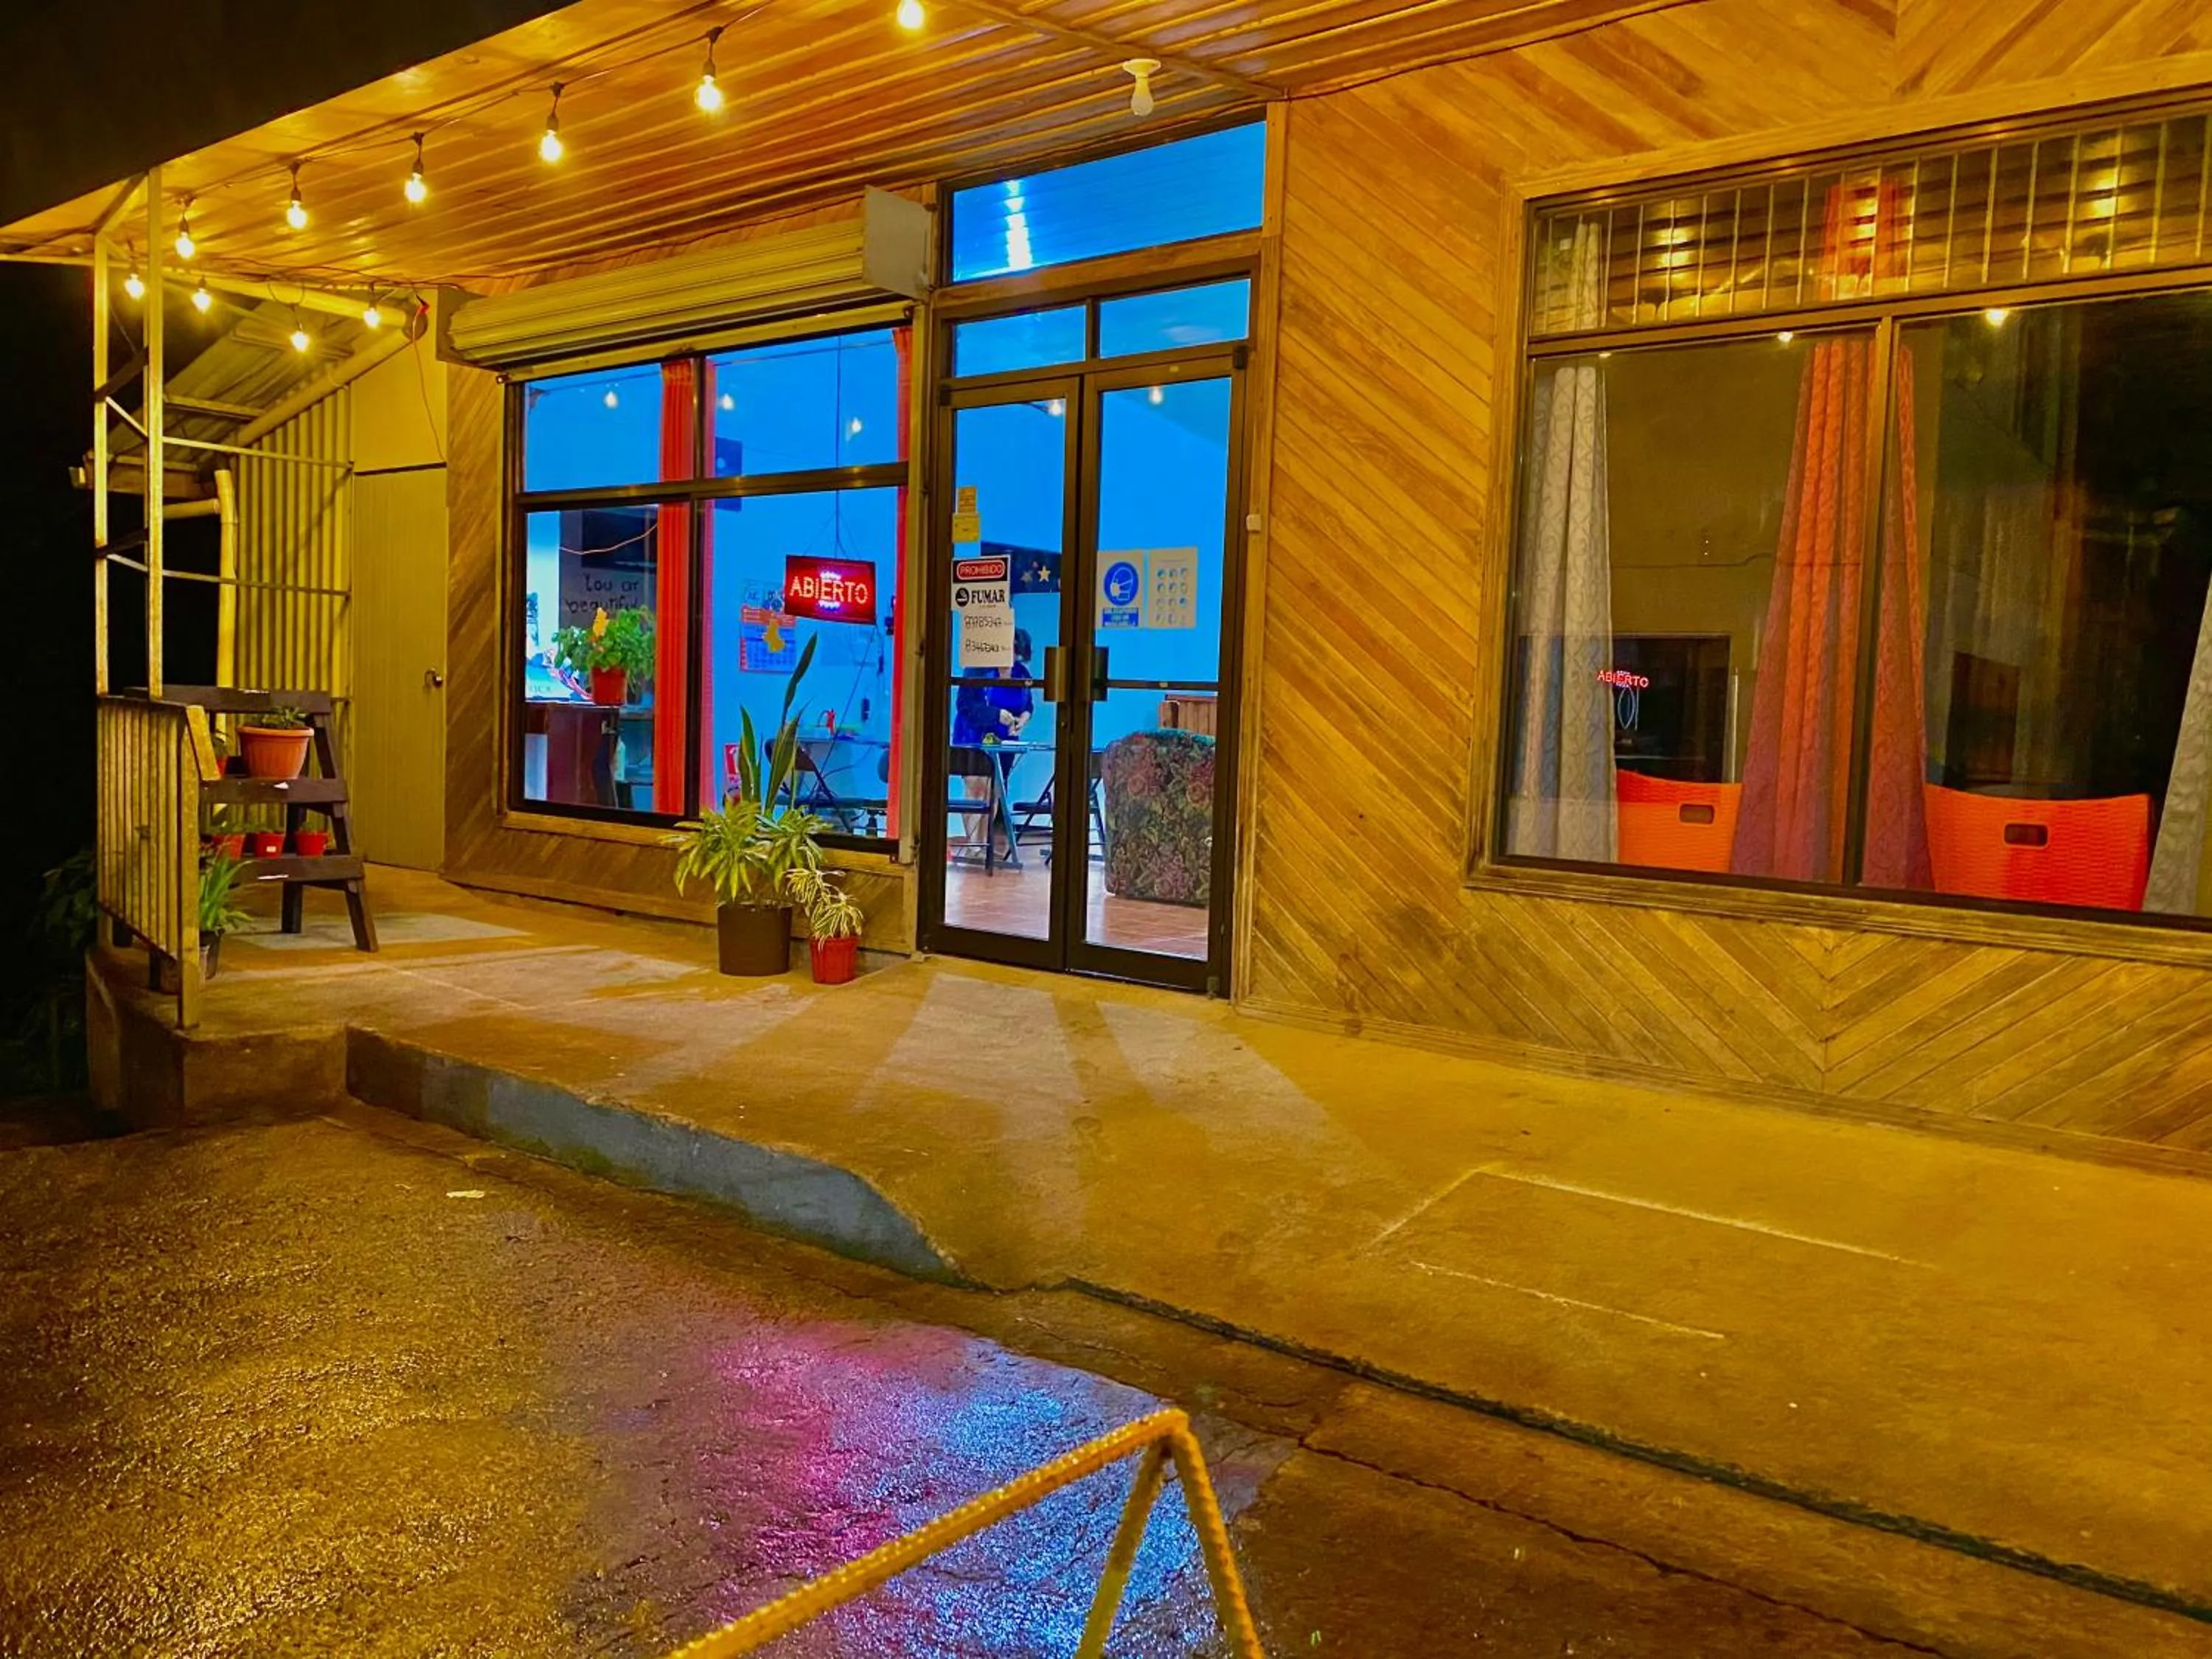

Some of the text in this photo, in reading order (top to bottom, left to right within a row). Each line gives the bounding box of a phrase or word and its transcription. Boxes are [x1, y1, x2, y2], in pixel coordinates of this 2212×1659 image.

[790, 576, 869, 604] ABIERTO
[971, 589, 1006, 603] FUMAR
[1596, 669, 1649, 688] ABIERTO
